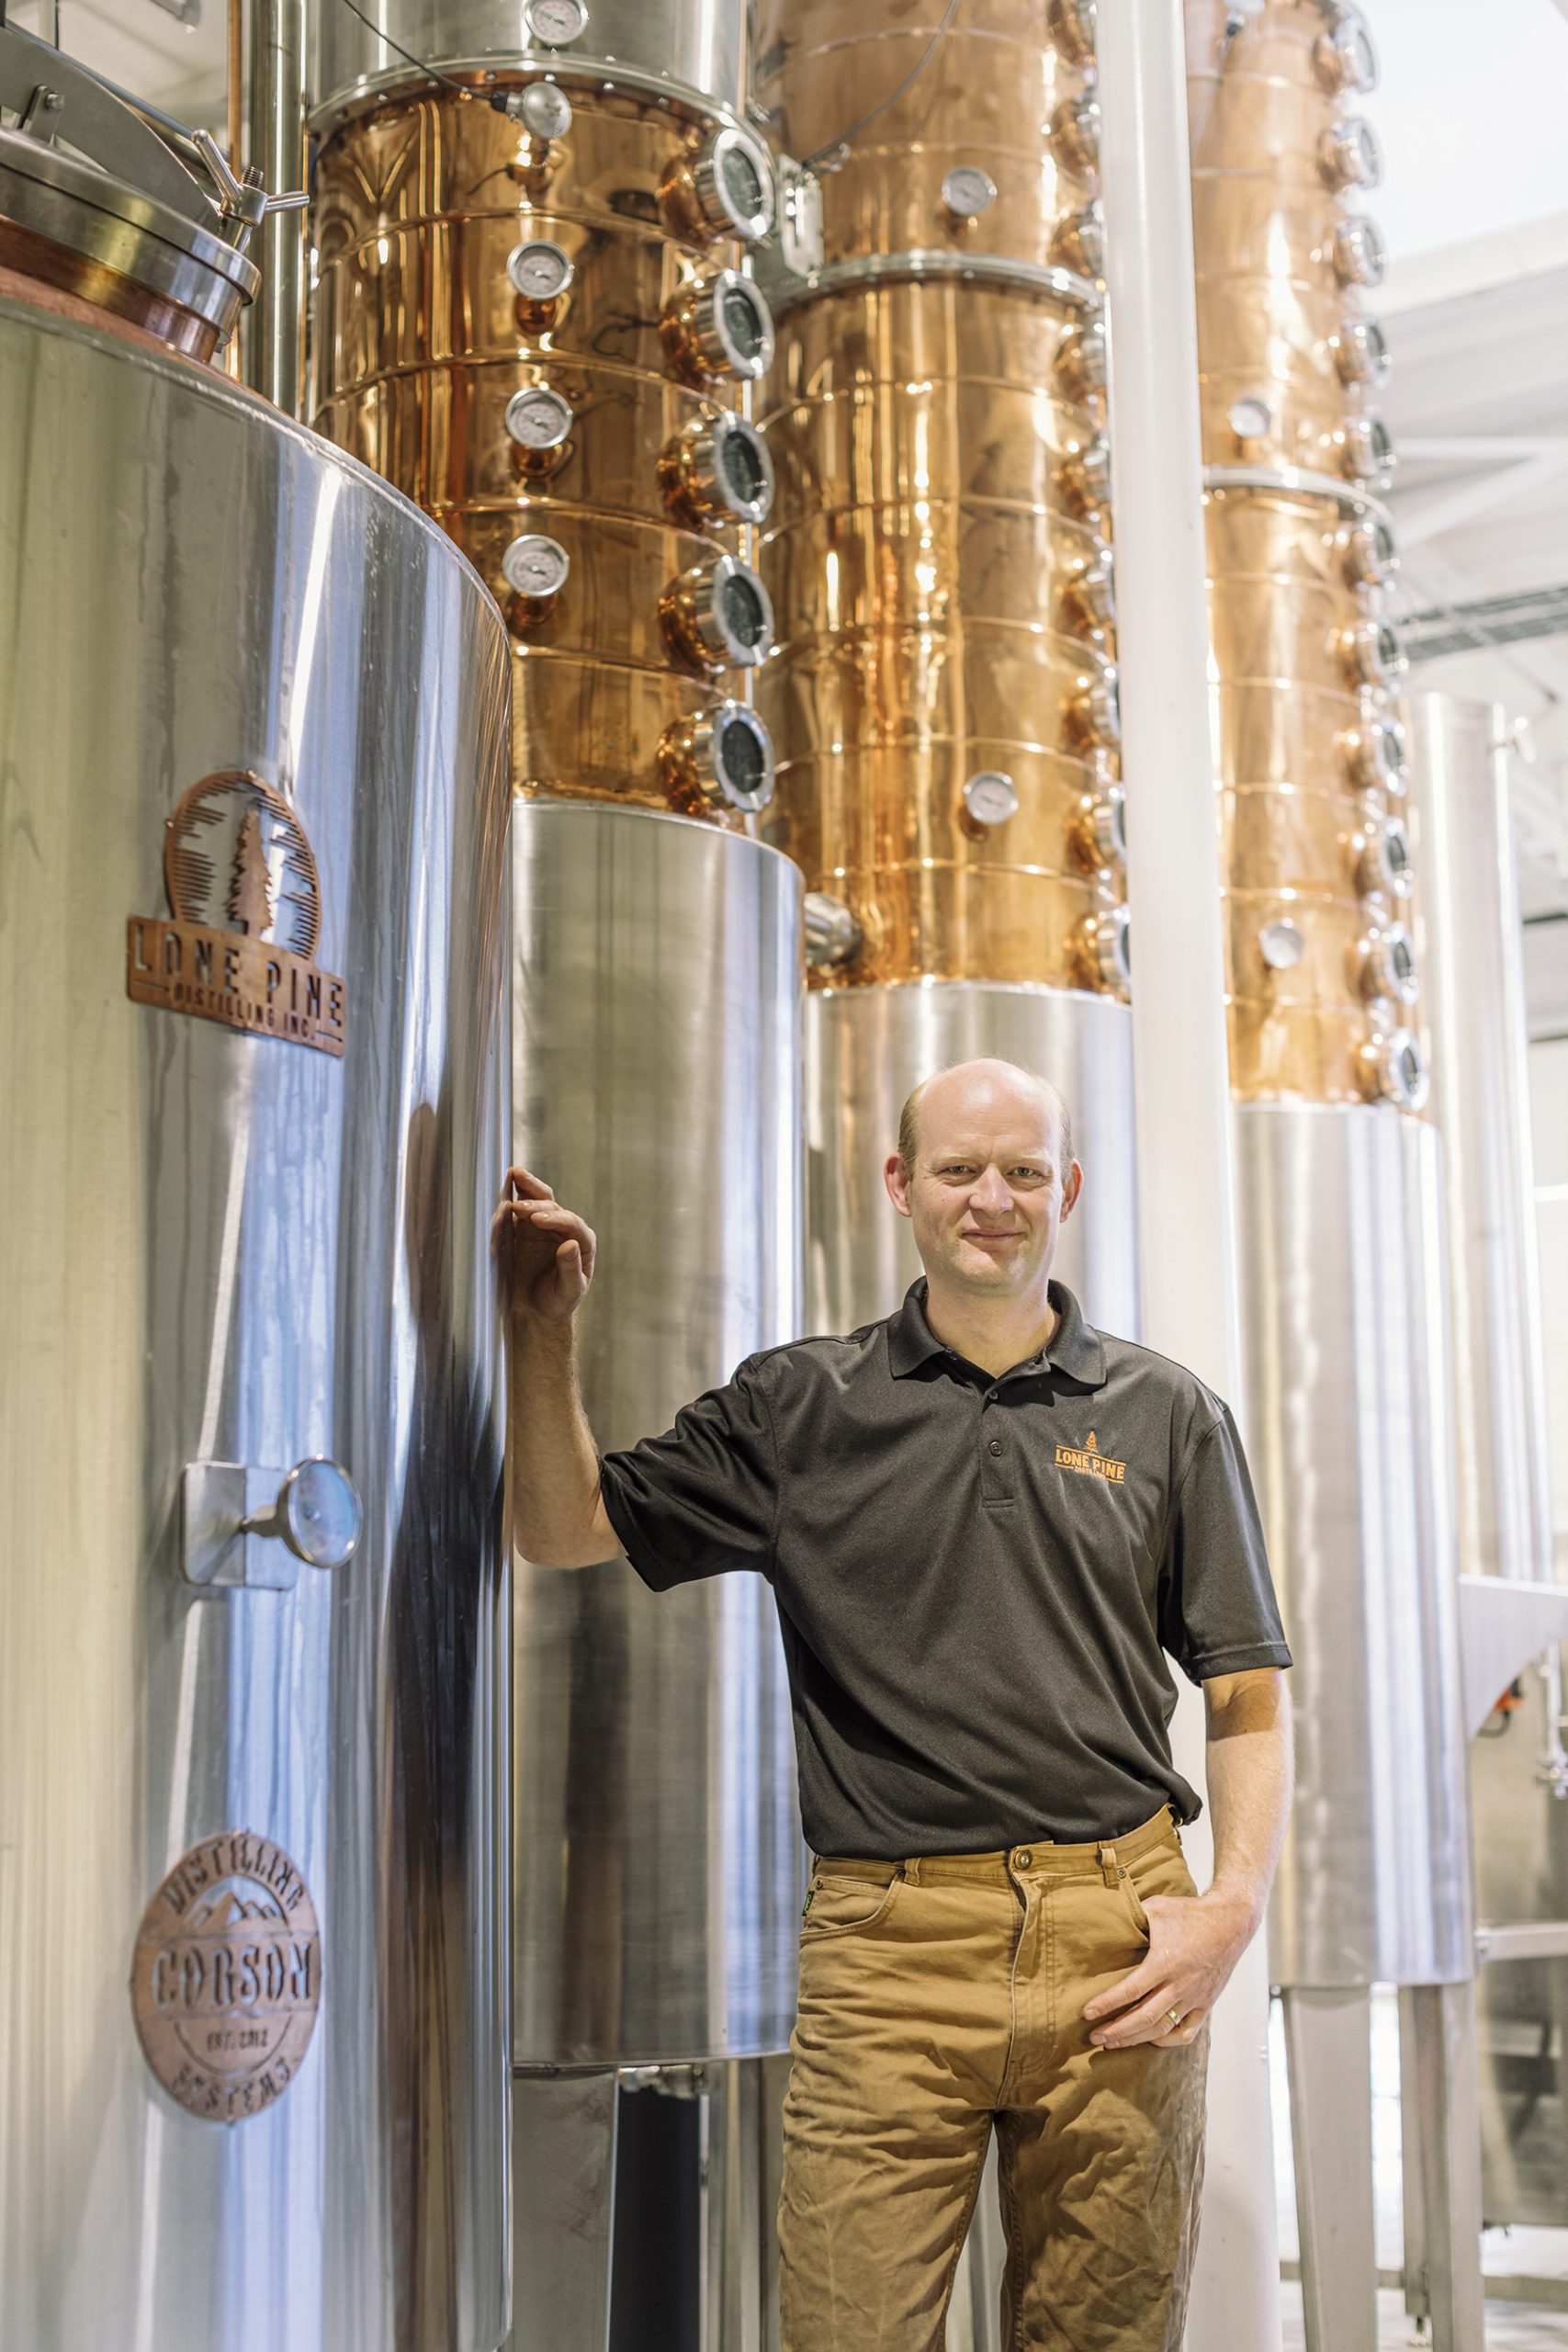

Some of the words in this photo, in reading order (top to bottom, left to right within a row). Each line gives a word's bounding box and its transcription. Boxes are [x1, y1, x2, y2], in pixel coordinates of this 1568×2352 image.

[135, 923, 240, 995] LONE
[266, 961, 343, 1028] PINE
[173, 982, 275, 1028] DISTILLING
[1055, 1449, 1089, 1468] LONE
[1092, 1458, 1125, 1480] PINE
[162, 1837, 305, 1916] DISTILLING
[152, 1941, 313, 2012] CORSON
